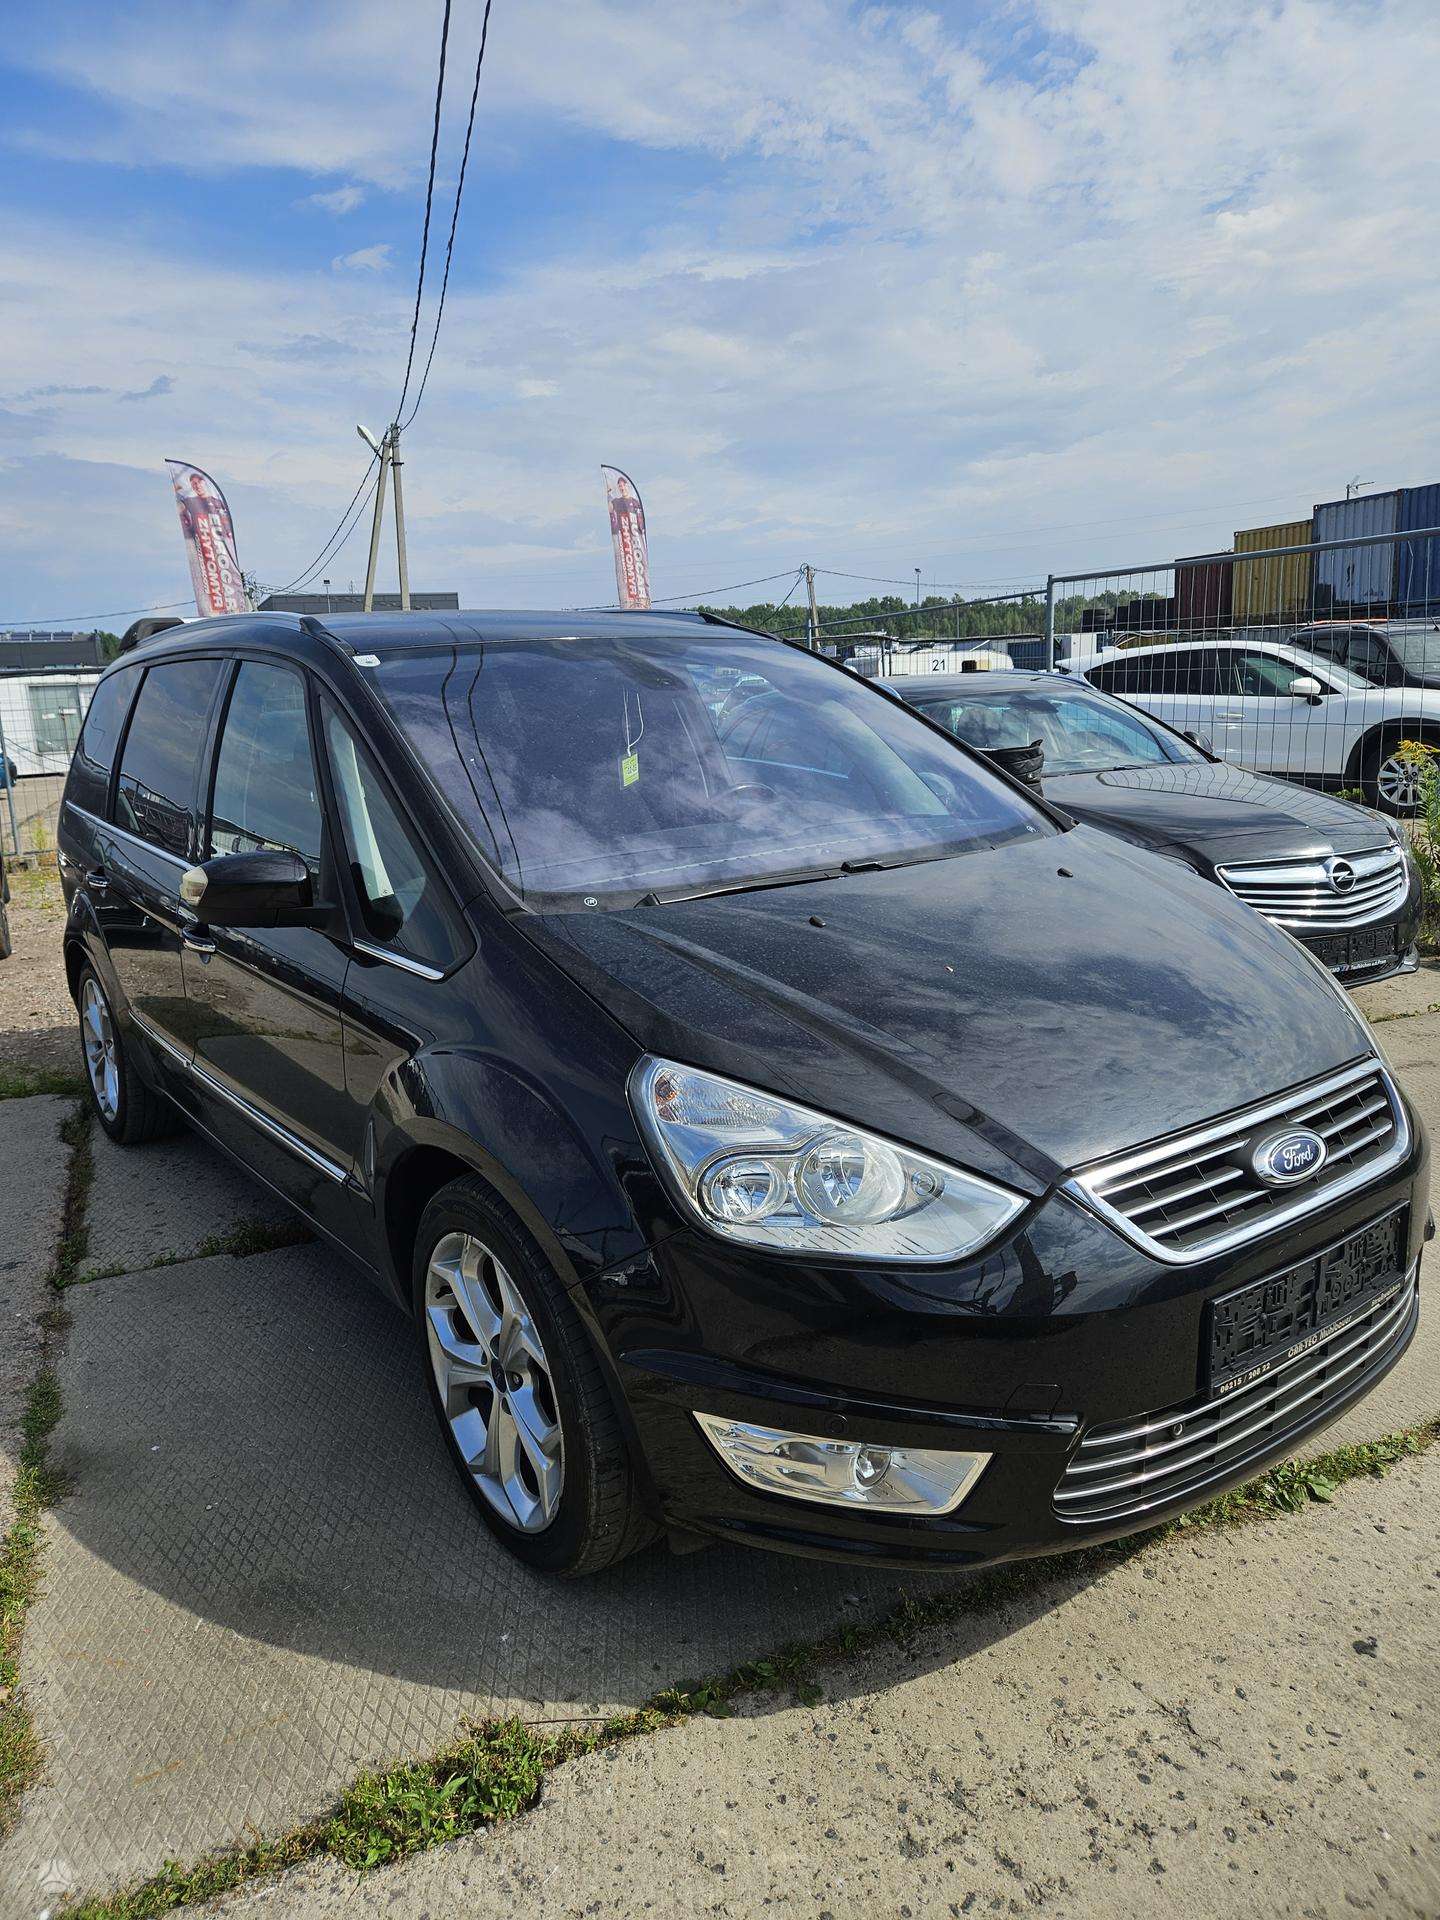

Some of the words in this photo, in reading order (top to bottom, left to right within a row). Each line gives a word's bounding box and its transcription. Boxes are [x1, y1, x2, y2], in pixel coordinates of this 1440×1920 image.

[198, 516, 223, 608] ZHYTOMYR
[208, 513, 238, 612] EUROCAR
[620, 516, 638, 597] ZHYTOMYR
[629, 511, 647, 598] EUROCAR
[932, 659, 945, 672] 21
[1283, 1143, 1314, 1171] Ford
